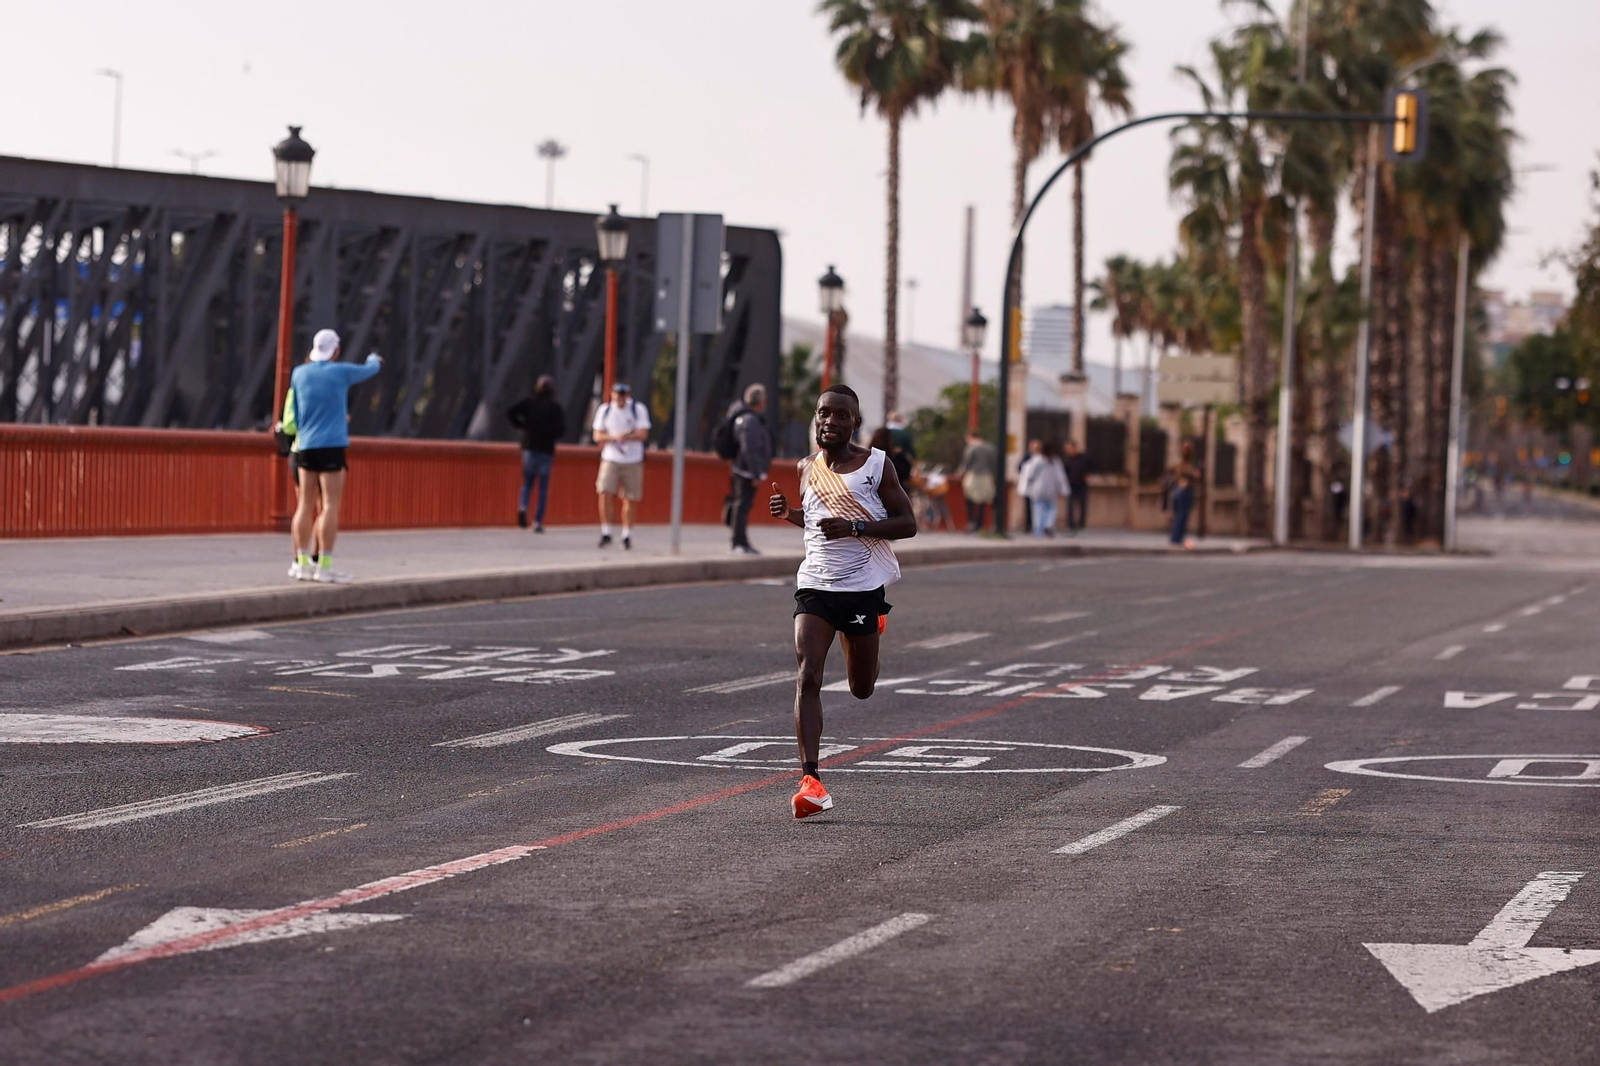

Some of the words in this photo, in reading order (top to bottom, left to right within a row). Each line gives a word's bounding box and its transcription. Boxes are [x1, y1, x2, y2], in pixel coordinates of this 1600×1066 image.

[336, 643, 617, 664] RED
[985, 662, 1259, 683] RED
[697, 741, 1016, 769] 50
